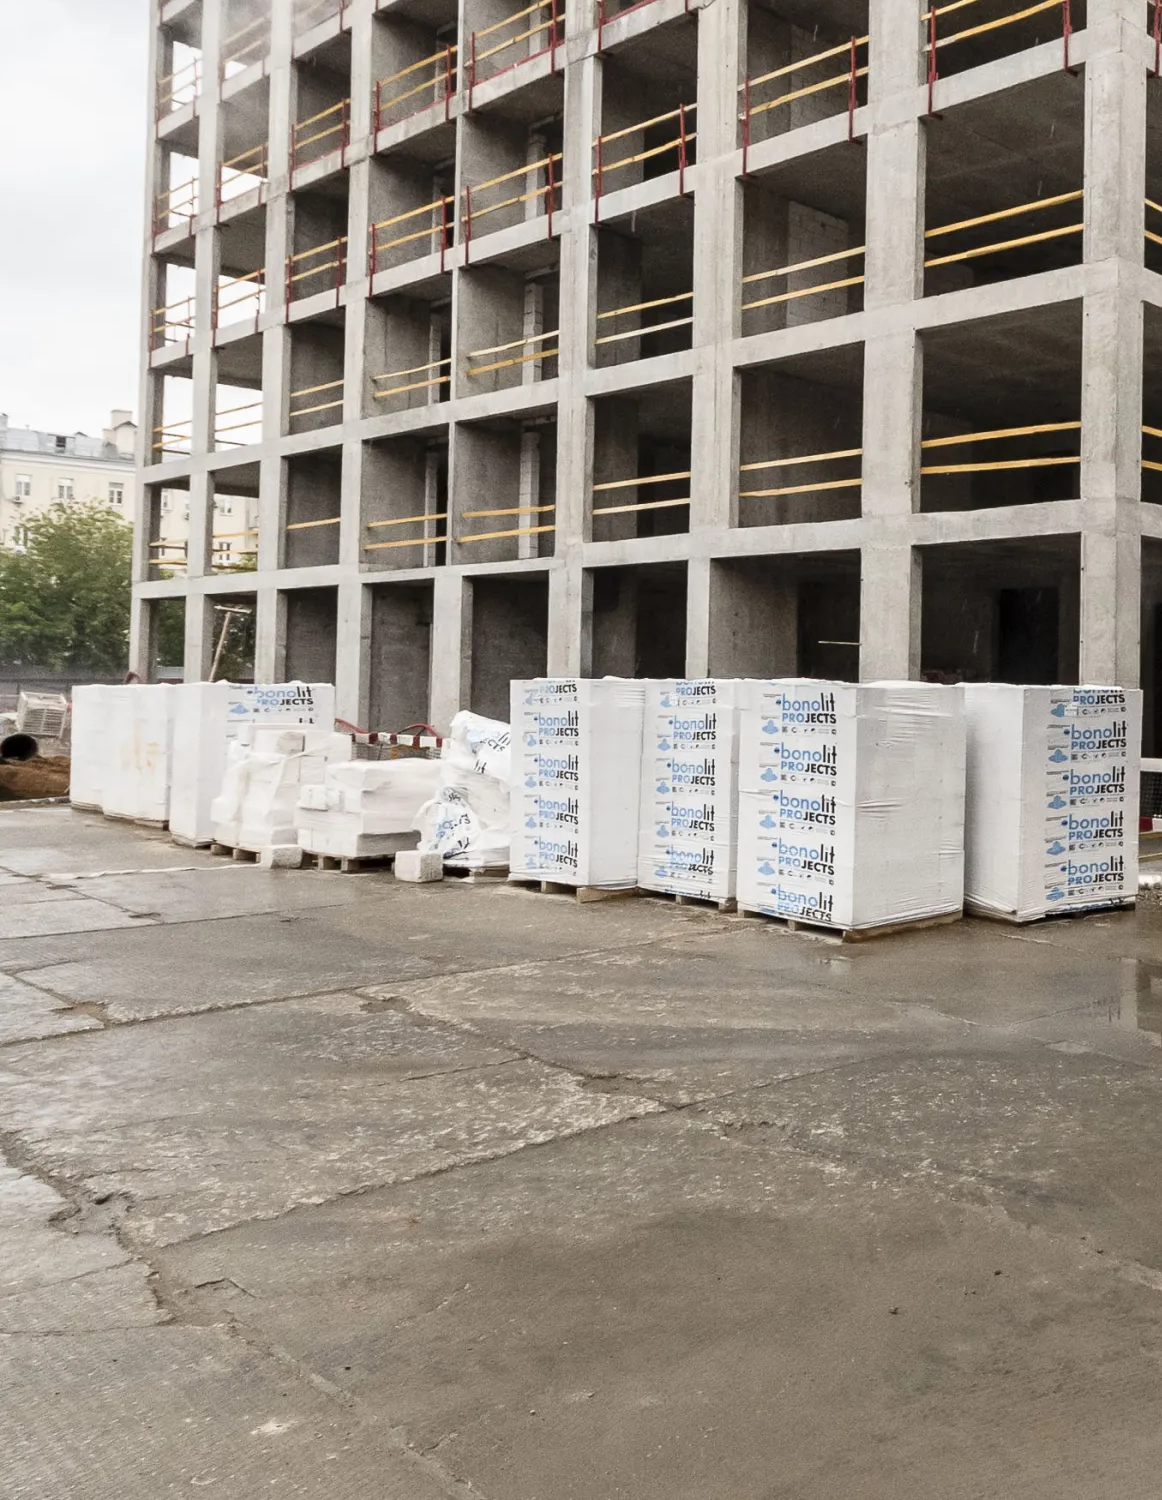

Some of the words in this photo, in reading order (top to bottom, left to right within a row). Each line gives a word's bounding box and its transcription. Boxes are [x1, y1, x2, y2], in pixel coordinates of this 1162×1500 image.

[676, 685, 716, 696] PROJECTS
[782, 692, 836, 713] bonolit
[1073, 694, 1125, 705] PROJECTS
[538, 711, 578, 728] bonolit
[673, 713, 717, 731] bonolit
[781, 713, 837, 724] PROJECTS
[538, 727, 579, 738] PROJECTS
[672, 731, 717, 742] PROJECTS
[1070, 721, 1127, 740] bonolit
[781, 742, 837, 764] bonolit
[1070, 739, 1127, 750] PROJECTS
[538, 754, 578, 771] bonolit
[671, 758, 716, 777] bonolit
[781, 761, 837, 776] PROJECTS
[538, 768, 579, 782] PROJECTS
[671, 774, 716, 786] PROJECTS
[1070, 766, 1126, 785] bonolit
[1069, 784, 1125, 795] PROJECTS
[538, 797, 579, 815] bonolit
[780, 789, 836, 814] bonolit
[539, 810, 579, 825] PROJECTS
[671, 804, 715, 821] bonolit
[779, 809, 836, 826] PROJECTS
[1068, 811, 1124, 830] bonolit
[671, 818, 715, 832] PROJECTS
[1068, 829, 1123, 840] PROJECTS
[539, 840, 578, 858] bonolit
[778, 837, 836, 864] bonolit
[539, 852, 578, 868] PROJECTS
[778, 856, 835, 876] PROJECTS
[1067, 856, 1124, 875] bonolit
[1067, 872, 1124, 886] PROJECTS
[777, 883, 834, 912] bonolit
